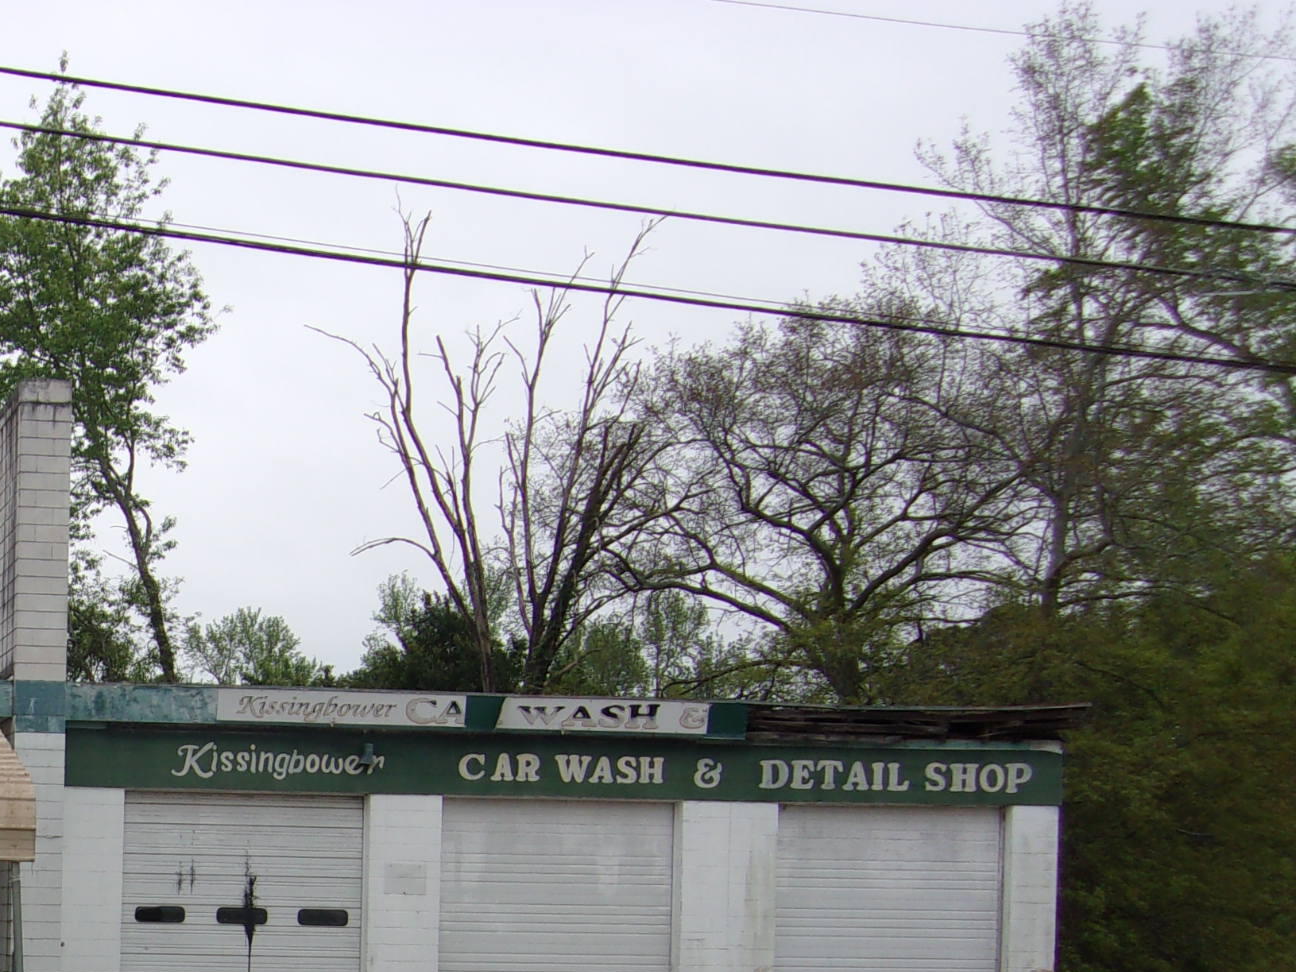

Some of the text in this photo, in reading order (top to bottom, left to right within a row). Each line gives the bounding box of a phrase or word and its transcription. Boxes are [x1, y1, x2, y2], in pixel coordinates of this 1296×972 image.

[236, 695, 397, 721] Kissingbower
[405, 697, 466, 725] CA
[517, 704, 661, 730] WASH
[171, 742, 1033, 794] Kissingbower CAR WASH & DETAIL SHOP
